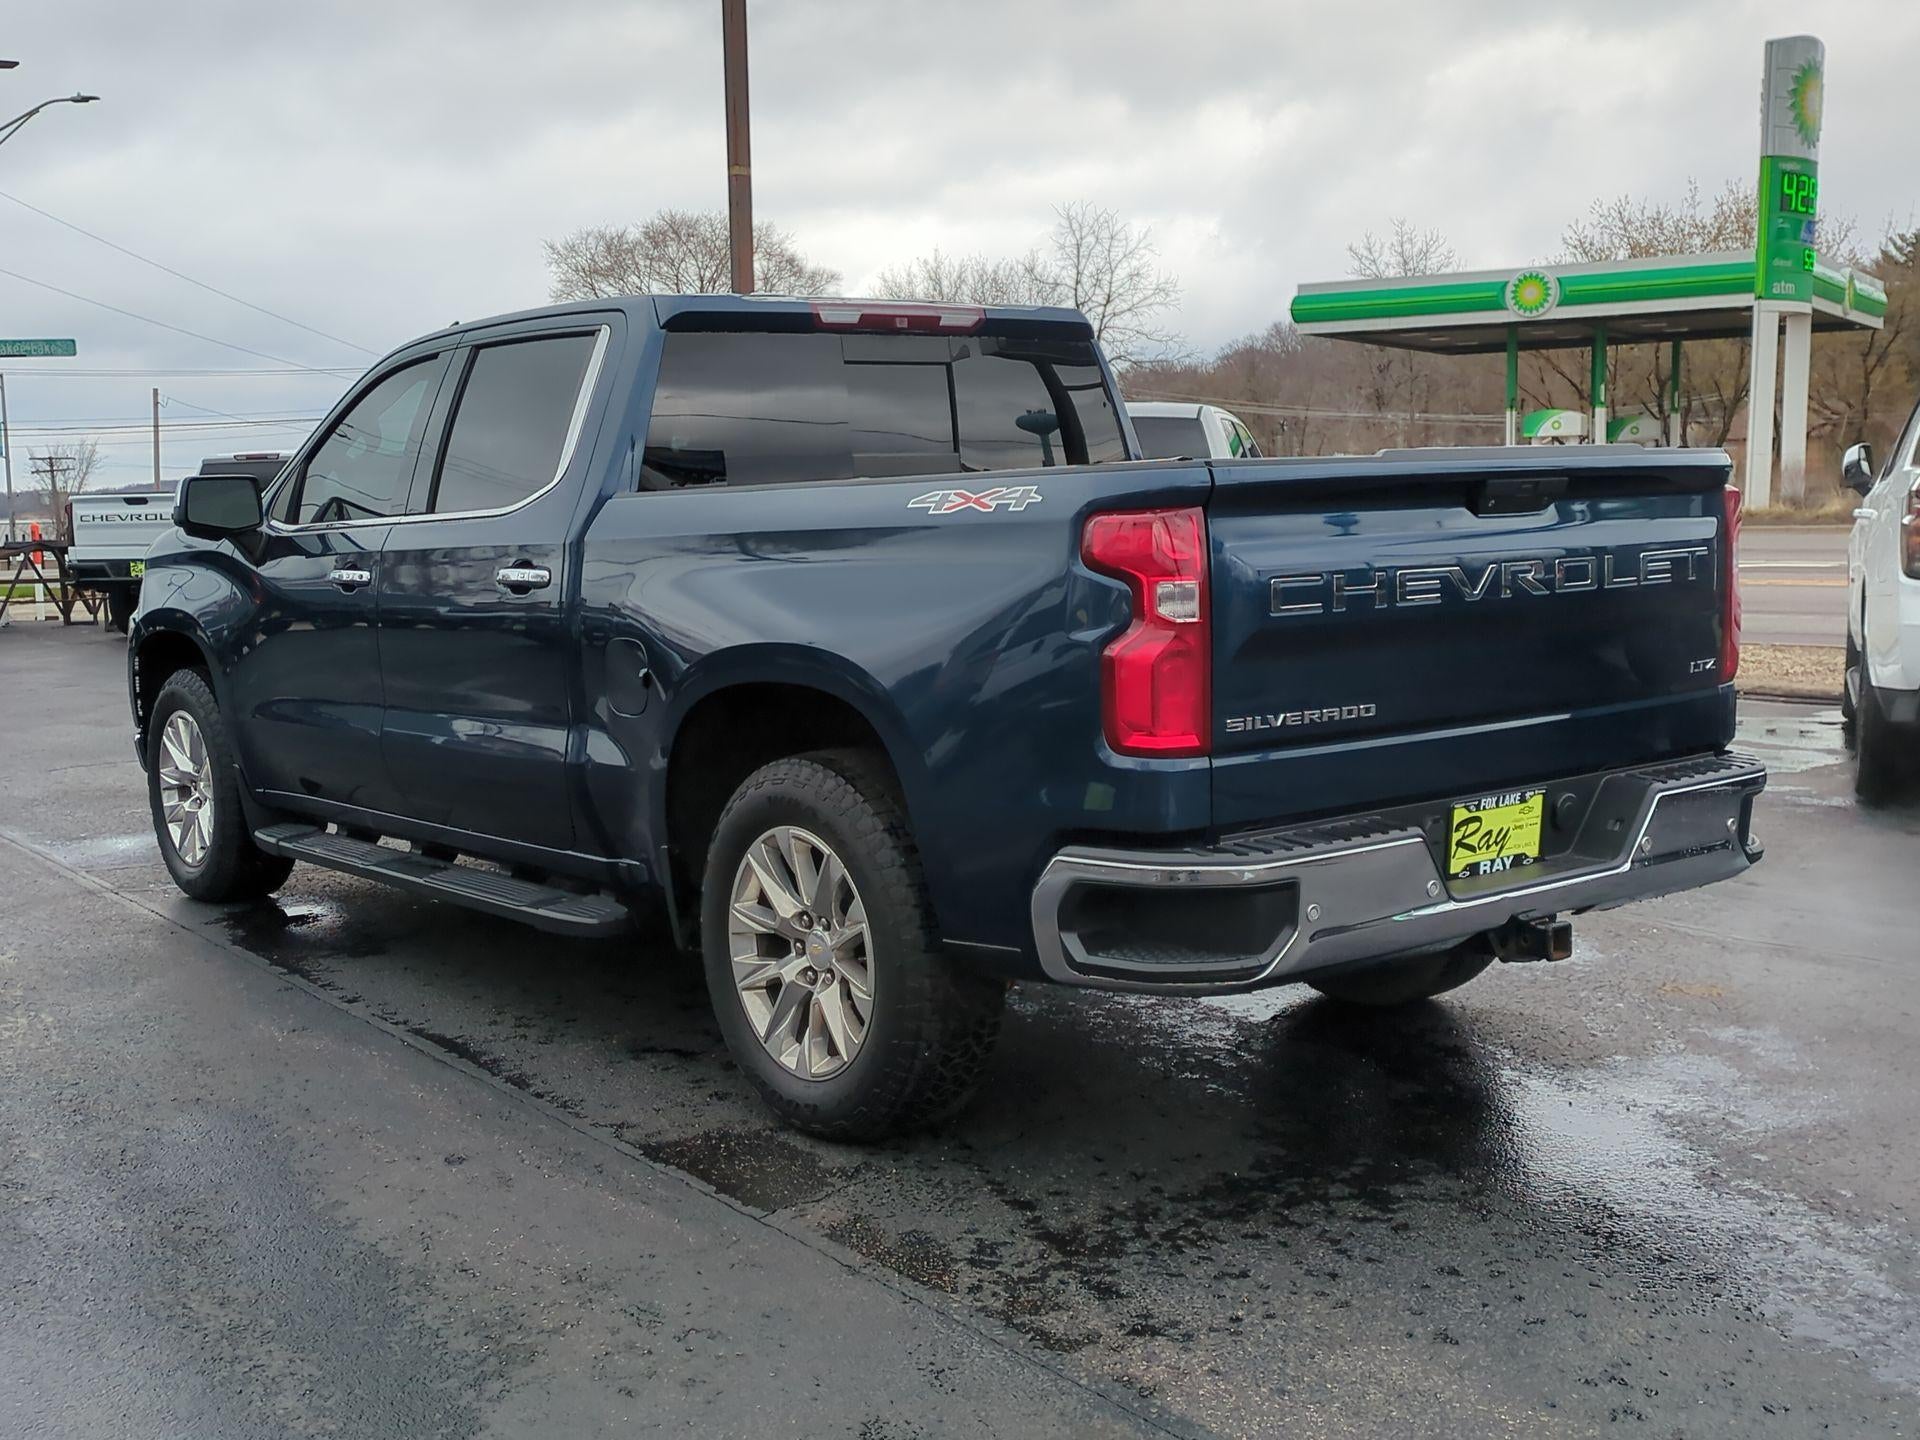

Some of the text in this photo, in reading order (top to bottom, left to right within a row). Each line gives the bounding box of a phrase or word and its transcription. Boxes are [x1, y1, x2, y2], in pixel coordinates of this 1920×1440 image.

[1772, 280, 1796, 295] atm
[1269, 546, 1709, 617] CHEVROLET
[1690, 657, 1716, 674] LTZ
[1225, 703, 1377, 732] SILVERADO
[1480, 792, 1521, 811] FOX LAKE
[1452, 815, 1511, 860] Ray
[1480, 855, 1515, 875] RAY
